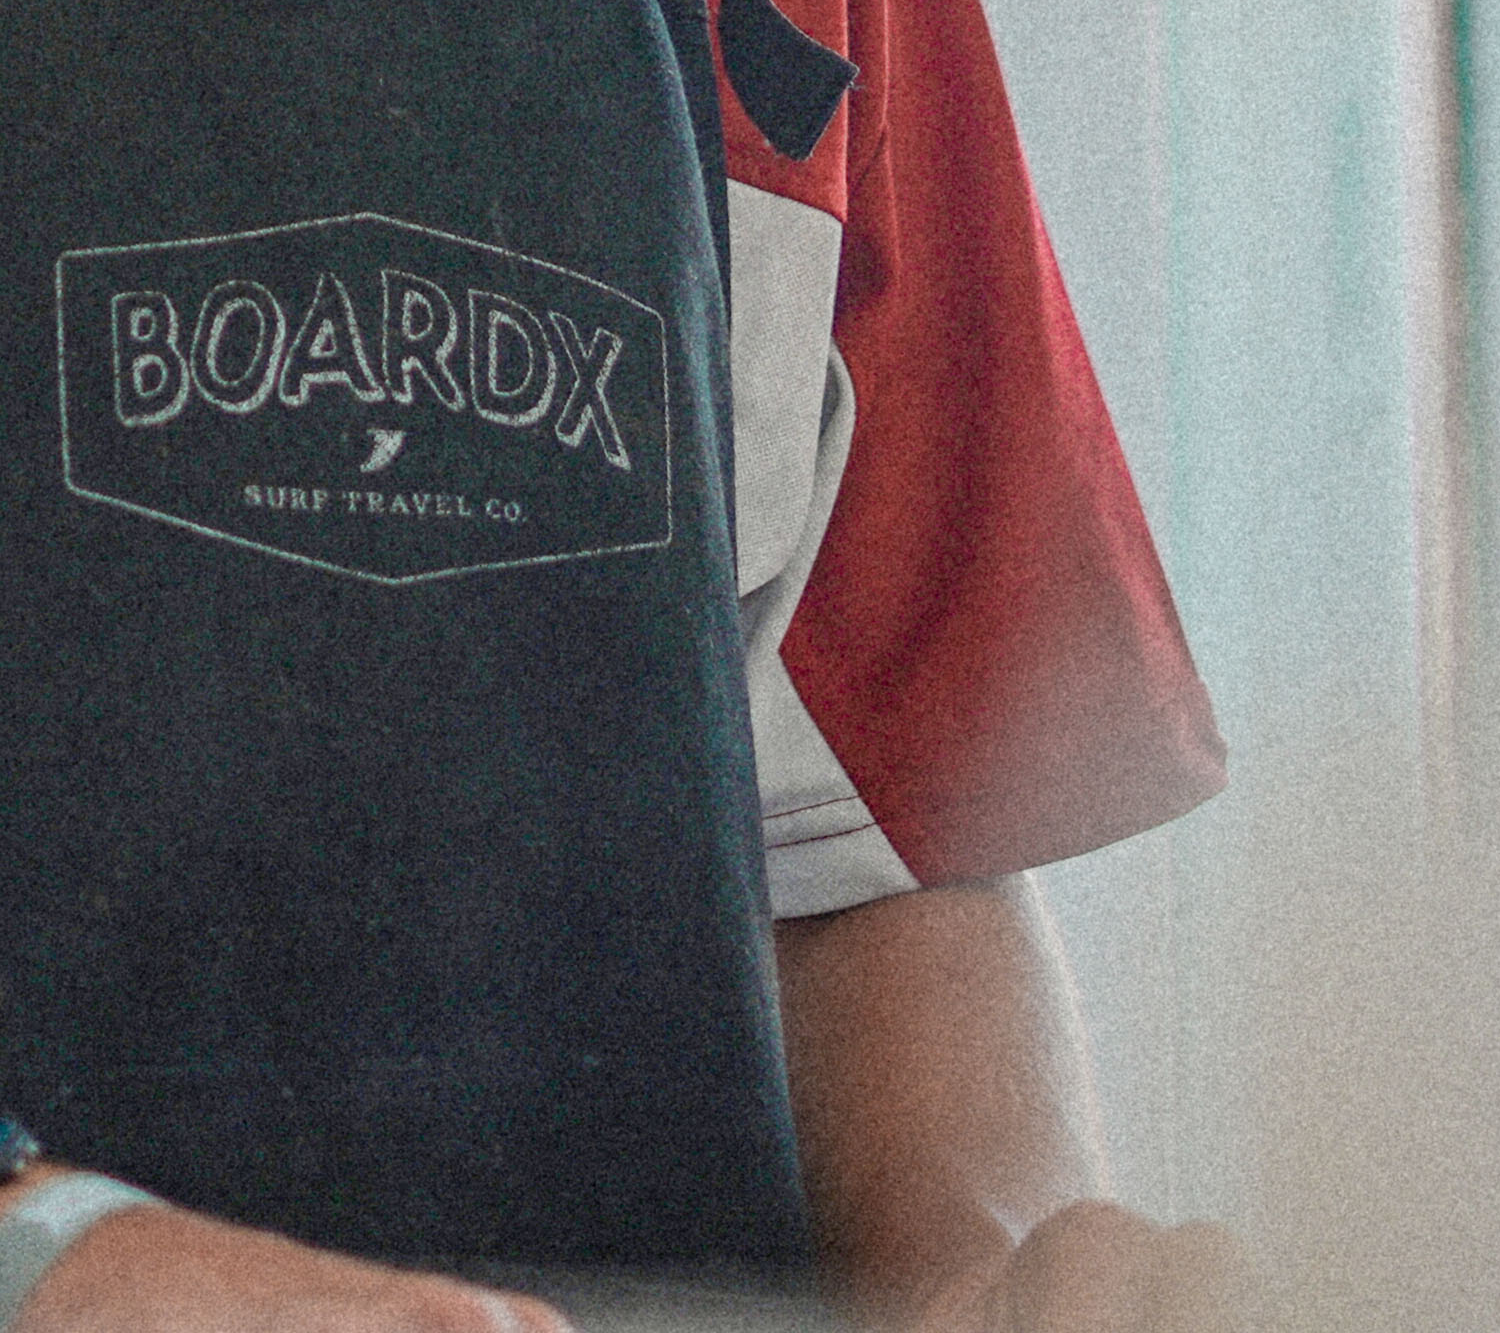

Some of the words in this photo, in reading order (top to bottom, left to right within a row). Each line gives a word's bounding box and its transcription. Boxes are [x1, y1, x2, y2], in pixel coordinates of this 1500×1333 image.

[111, 268, 632, 471] BOARDX
[243, 483, 329, 512] SURF
[341, 489, 472, 517] TRAVEL
[484, 496, 529, 524] CO.
